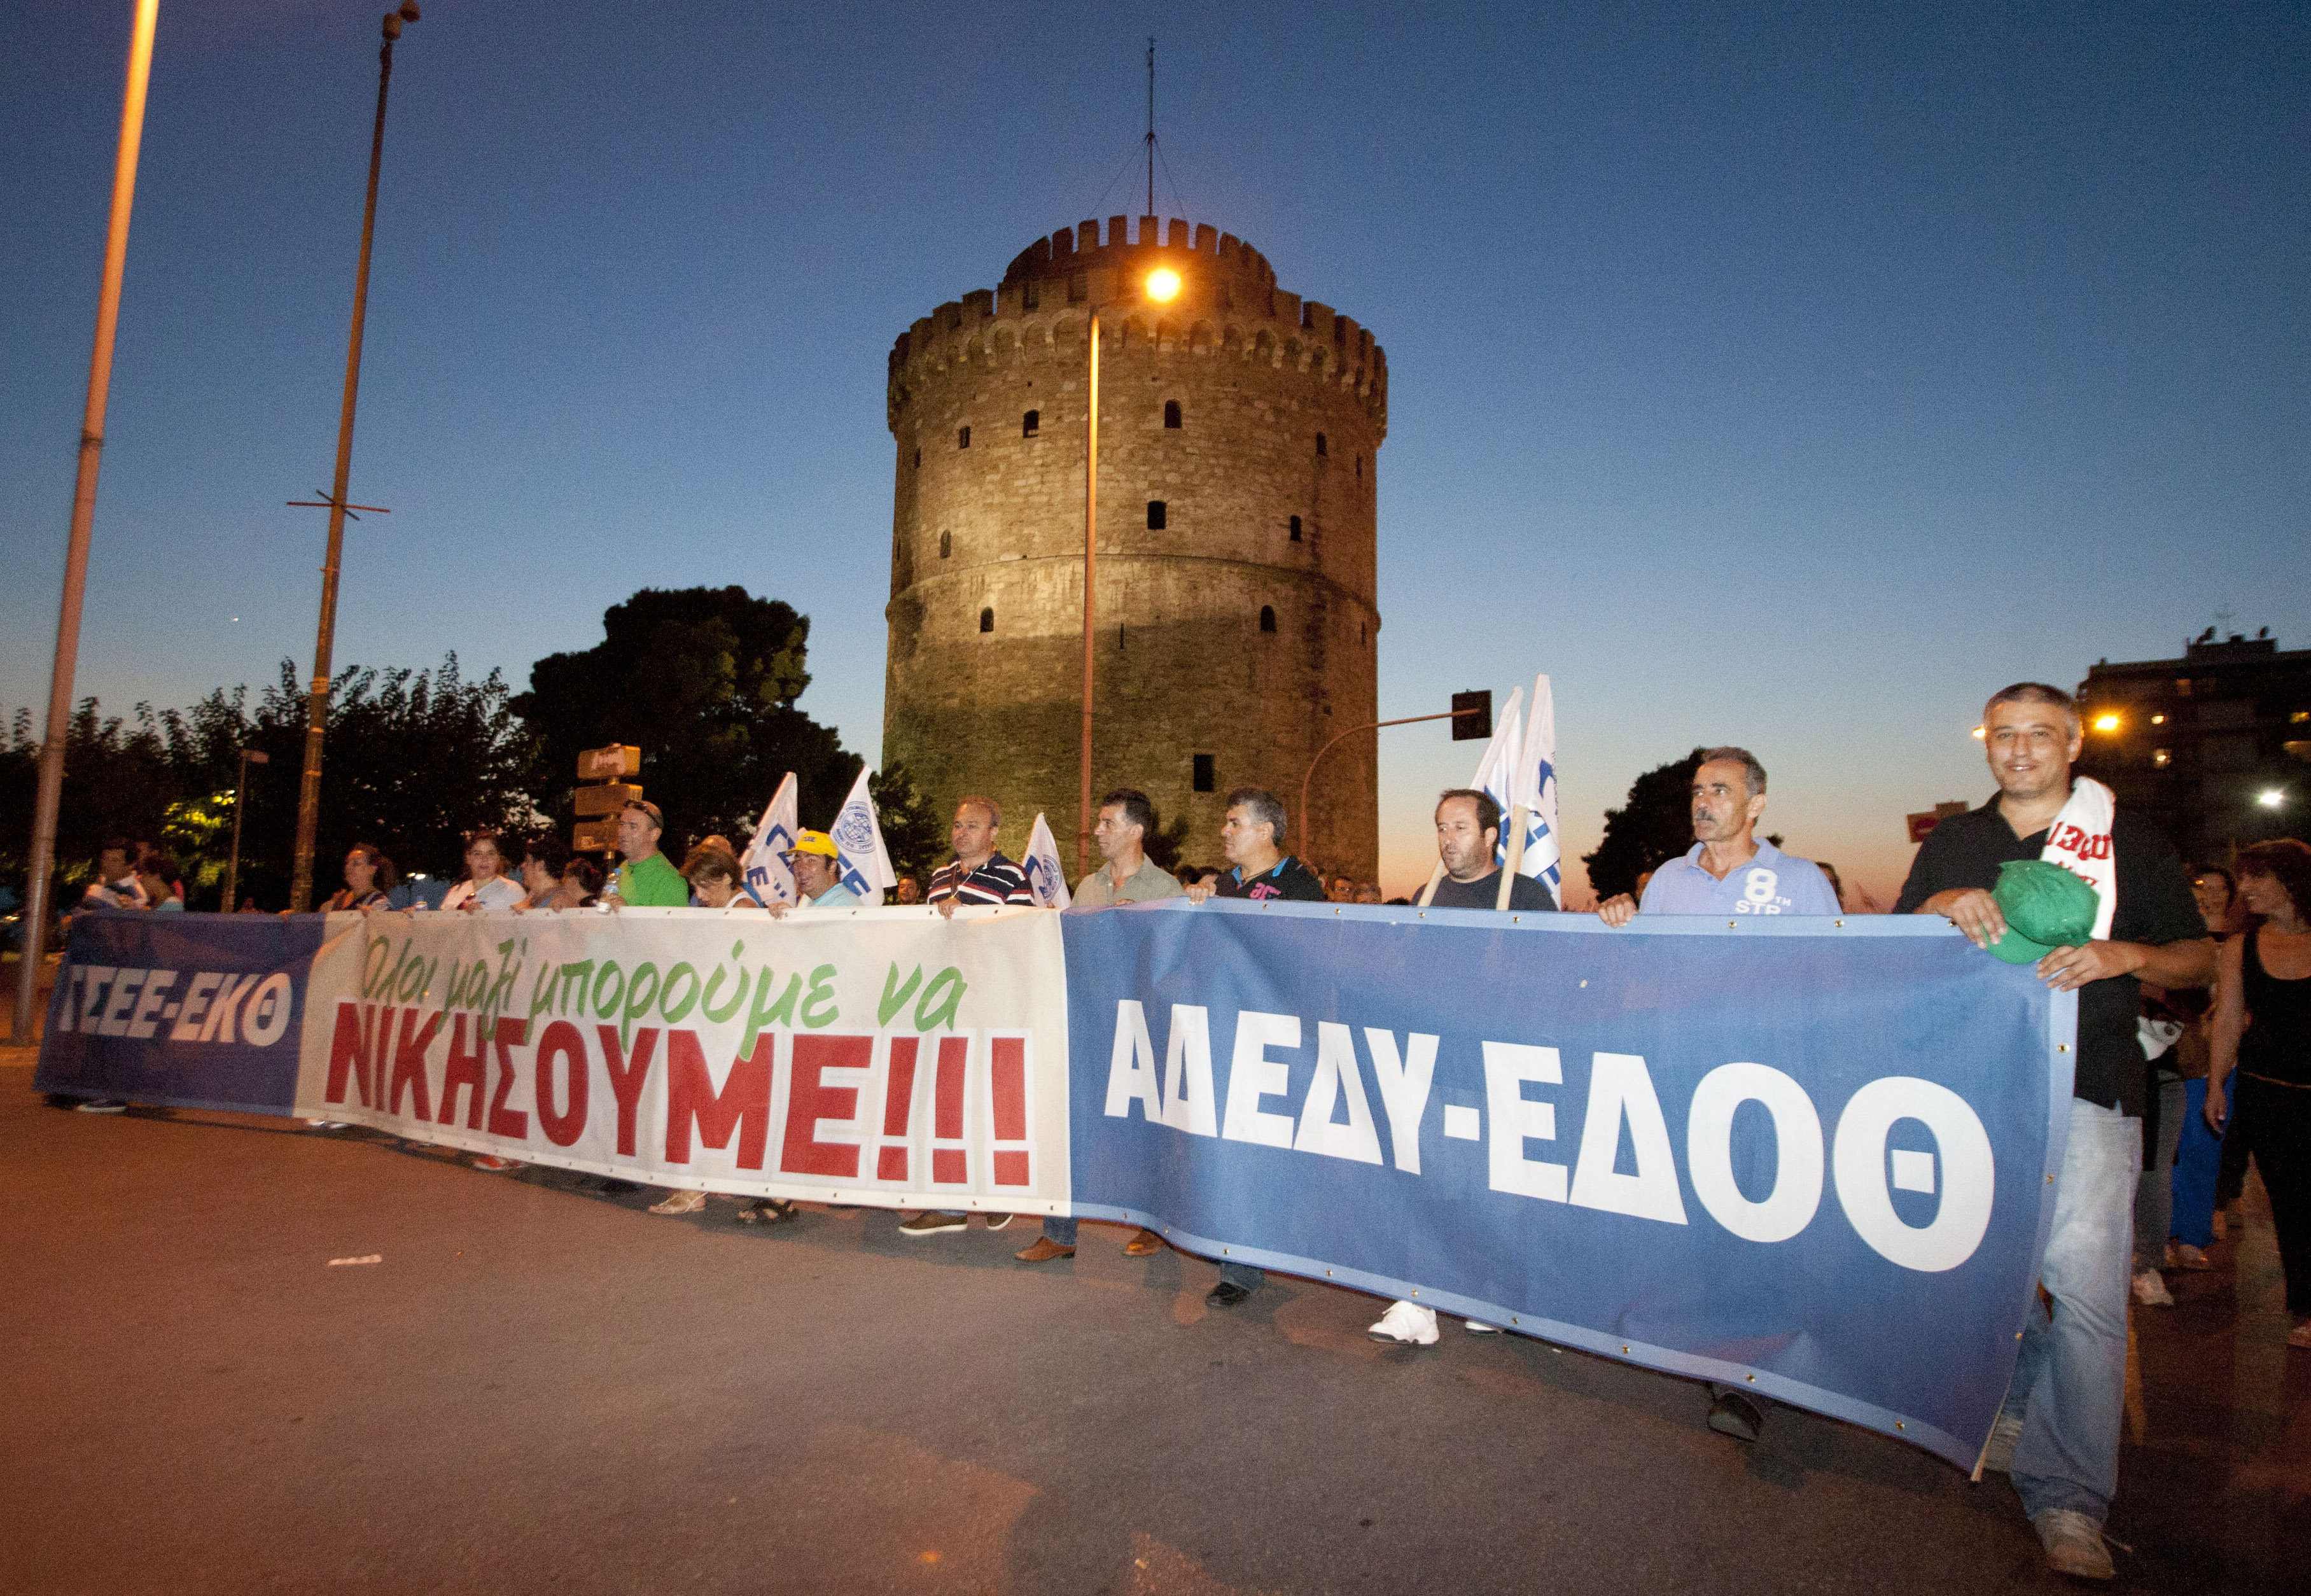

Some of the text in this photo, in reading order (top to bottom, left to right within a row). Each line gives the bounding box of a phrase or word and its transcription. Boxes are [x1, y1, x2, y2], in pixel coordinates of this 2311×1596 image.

[523, 939, 840, 1062] μπορούμε
[877, 960, 968, 1032] να
[325, 1002, 1030, 1186] ΝΙΚΗΣΟΥΜΕ!!!
[1104, 998, 1995, 1273] ΑΔΕΔΥ-ΕΔΟΘ
